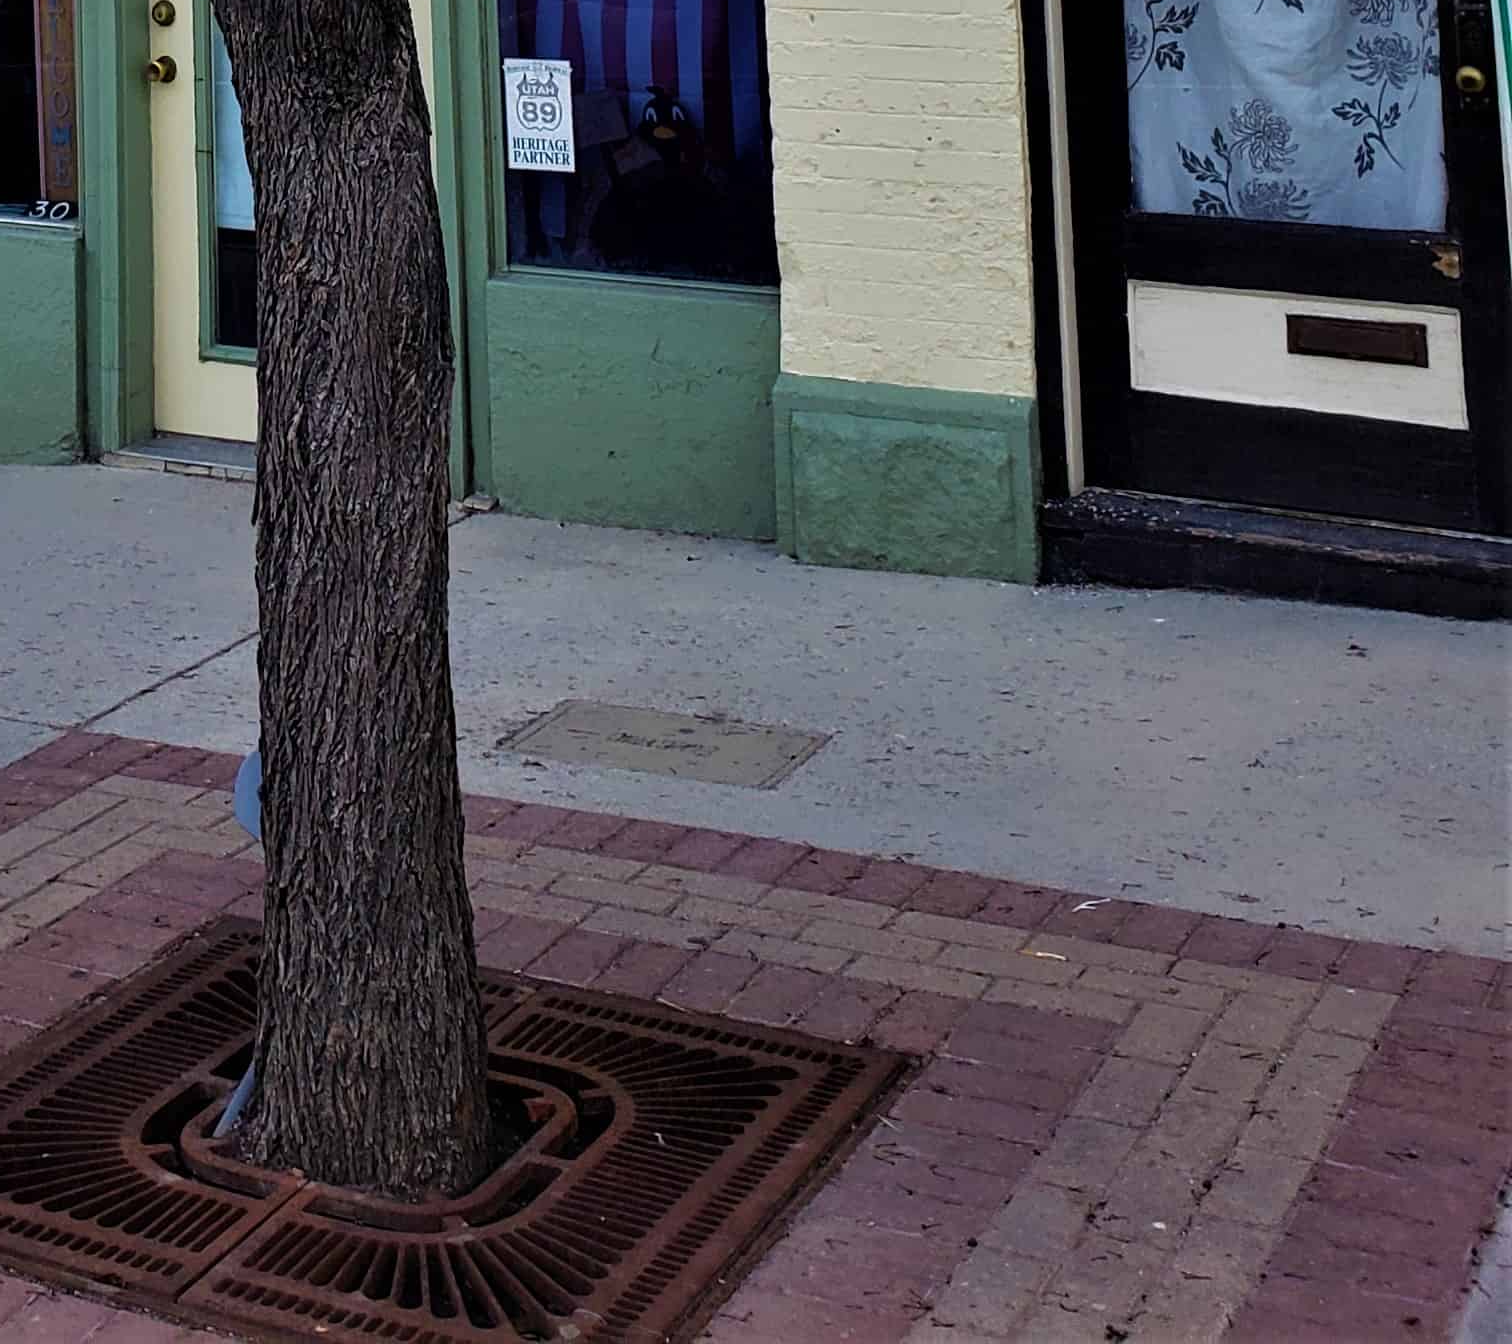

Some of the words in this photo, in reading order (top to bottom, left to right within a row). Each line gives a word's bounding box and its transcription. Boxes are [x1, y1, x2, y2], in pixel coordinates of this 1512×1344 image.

[521, 82, 556, 96] UTAH
[522, 100, 557, 124] 89
[512, 135, 569, 153] HERITAGE
[513, 150, 571, 166] PARTNER
[28, 200, 70, 220] 30
